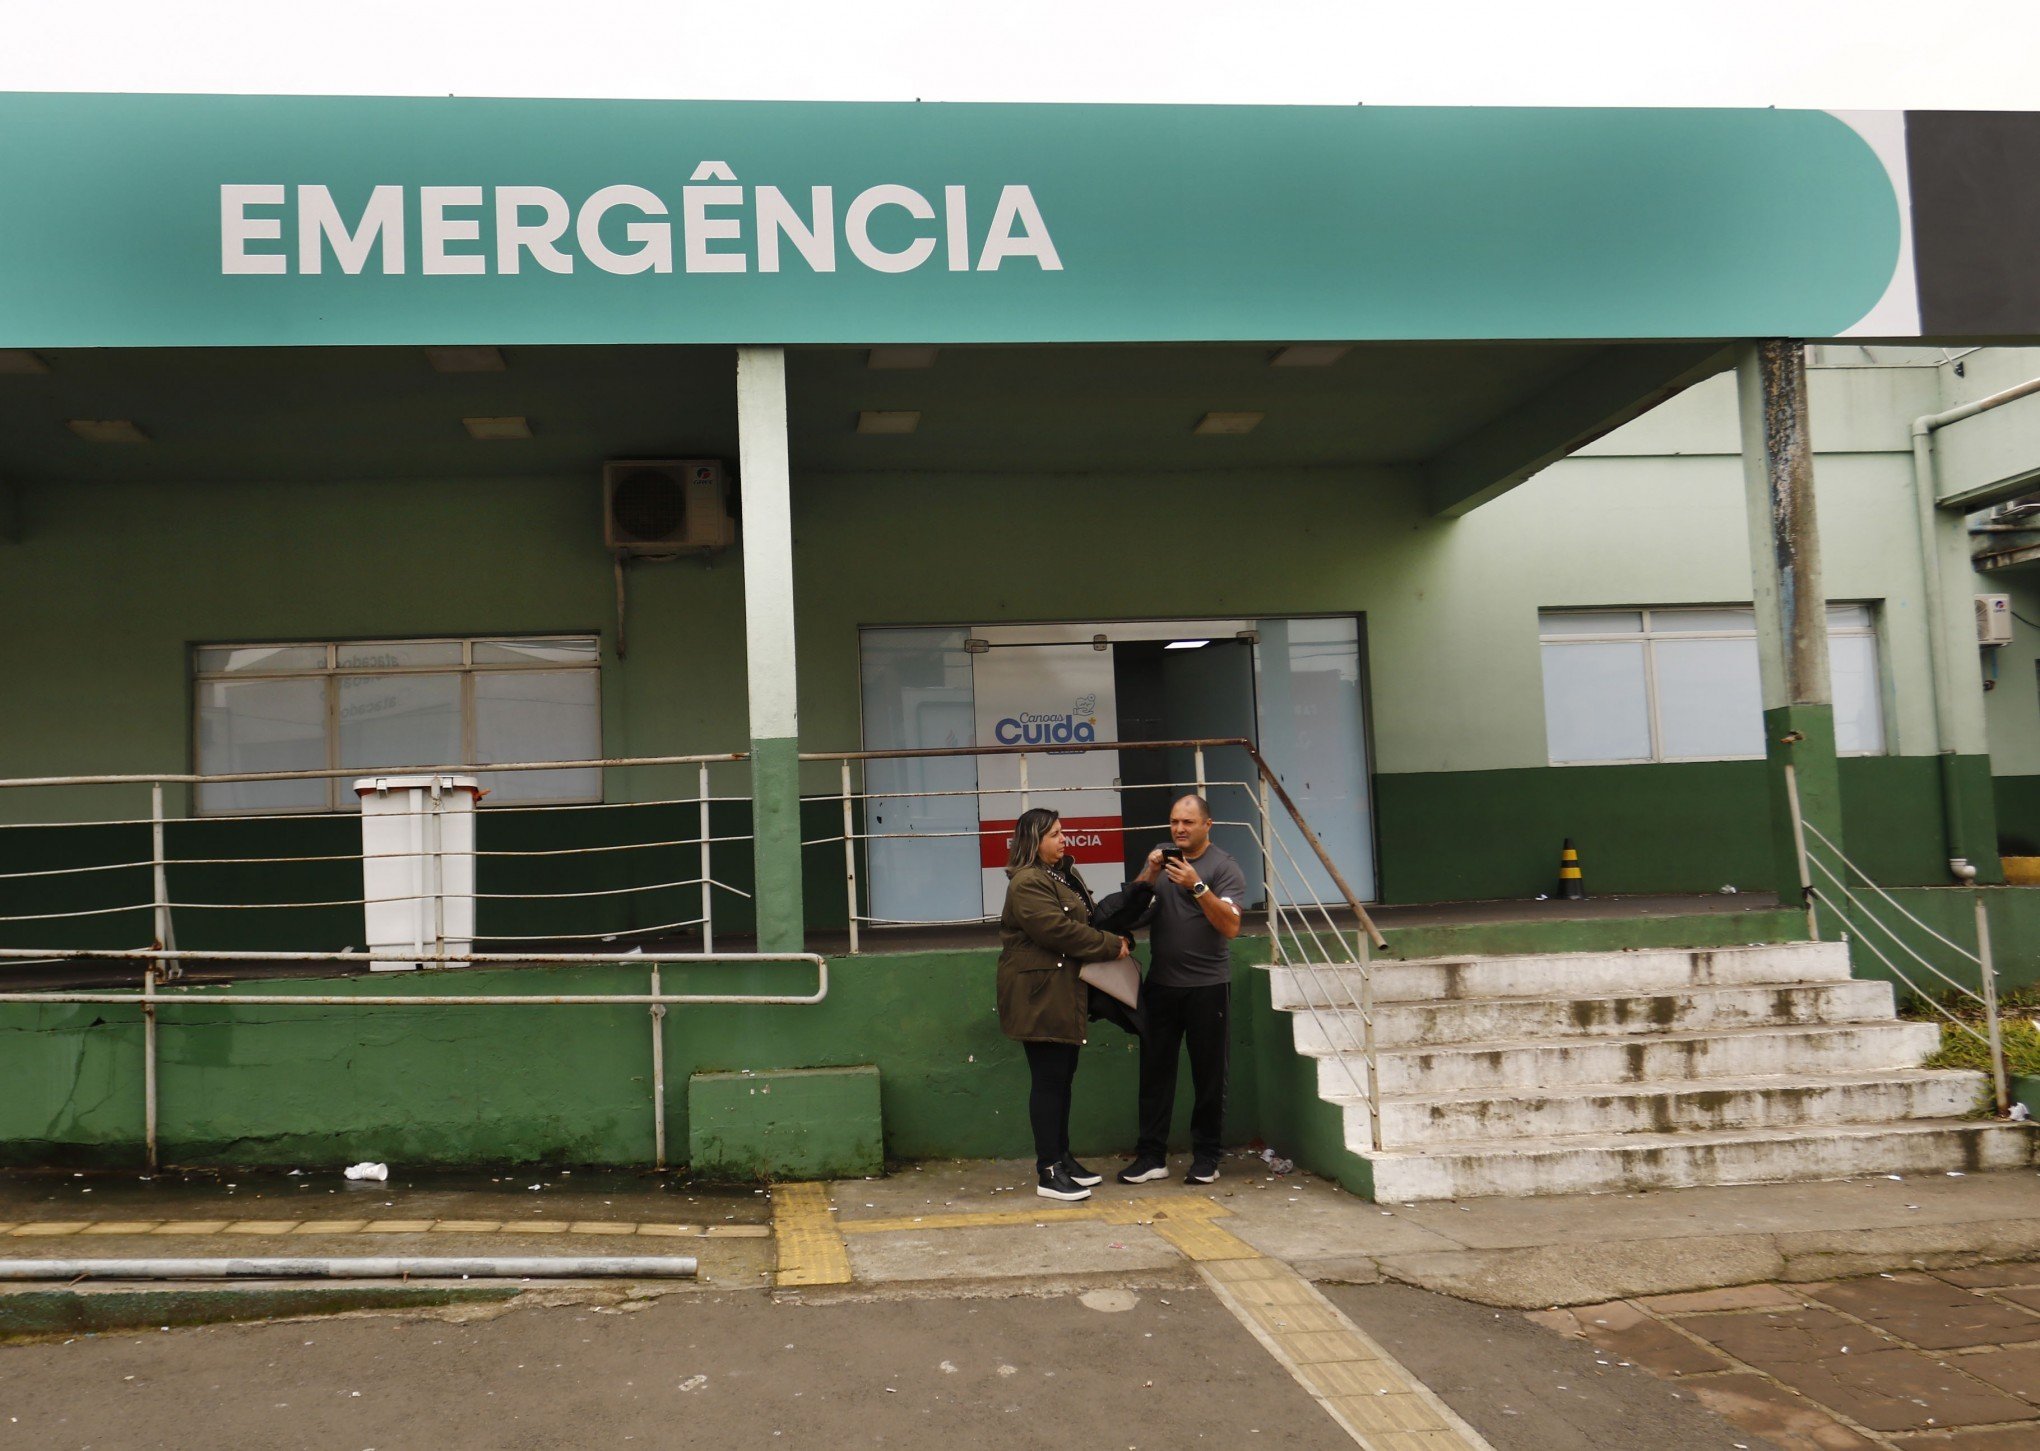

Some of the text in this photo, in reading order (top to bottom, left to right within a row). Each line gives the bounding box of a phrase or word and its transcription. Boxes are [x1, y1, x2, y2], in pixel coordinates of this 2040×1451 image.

[219, 159, 1064, 277] EMERGÊNCIA
[995, 714, 1095, 745] Cuida
[1020, 712, 1065, 724] Canoas
[1006, 834, 1102, 850] ENCIA
